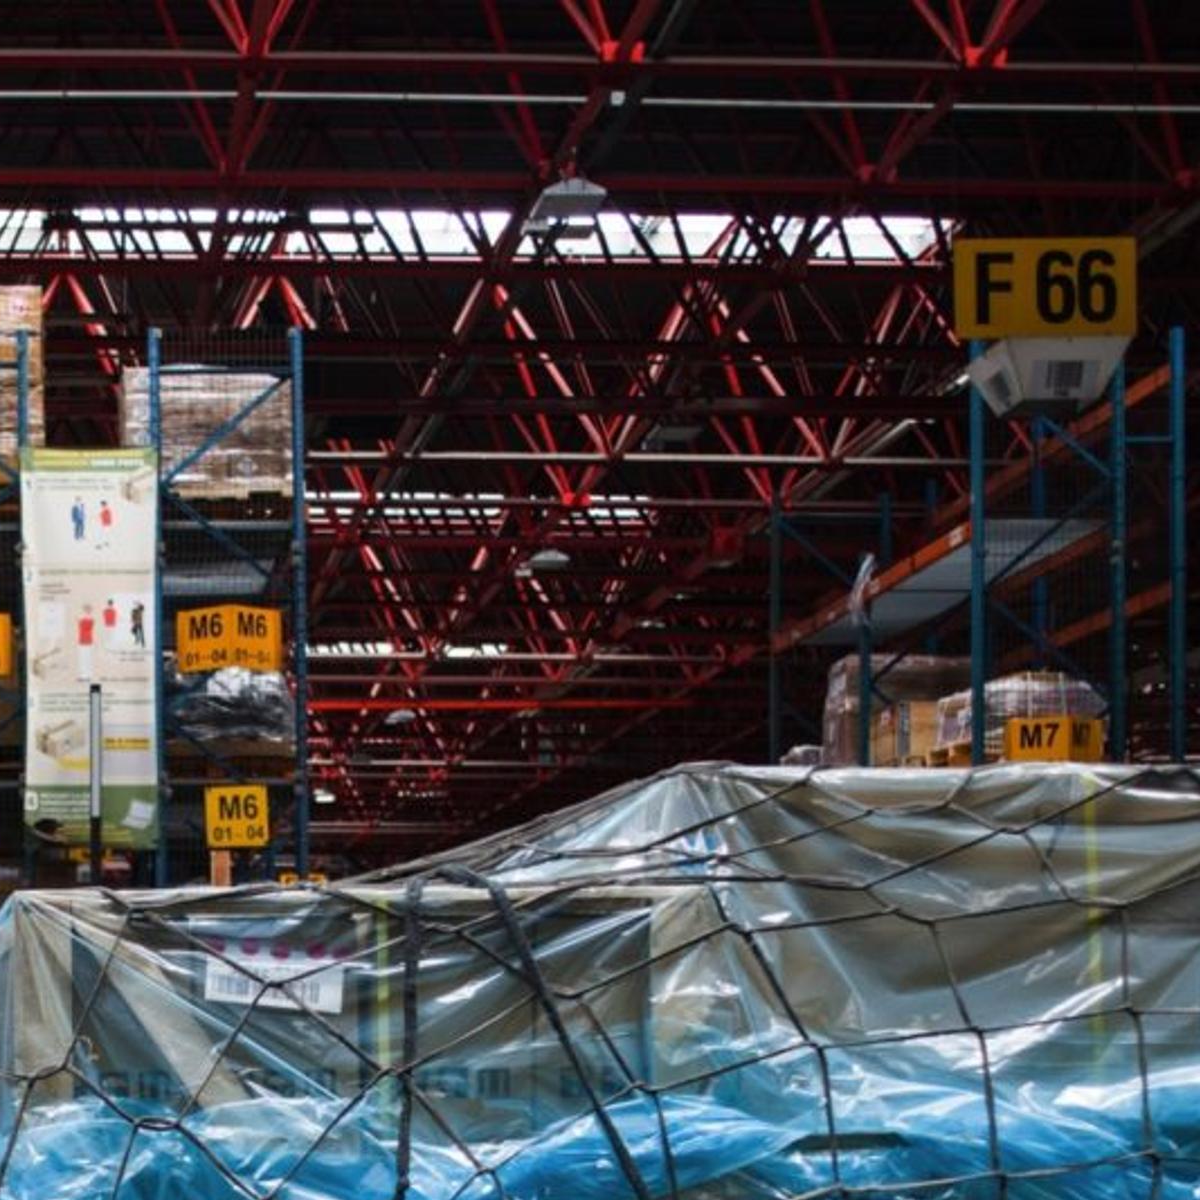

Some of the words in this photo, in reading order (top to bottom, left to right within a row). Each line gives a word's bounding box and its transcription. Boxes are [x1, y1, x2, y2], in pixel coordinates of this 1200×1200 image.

[976, 252, 1014, 325] F
[1036, 250, 1117, 324] 66
[189, 613, 223, 640] M6
[238, 611, 267, 638] M6
[1020, 723, 1059, 749] M7
[219, 794, 257, 820] M6
